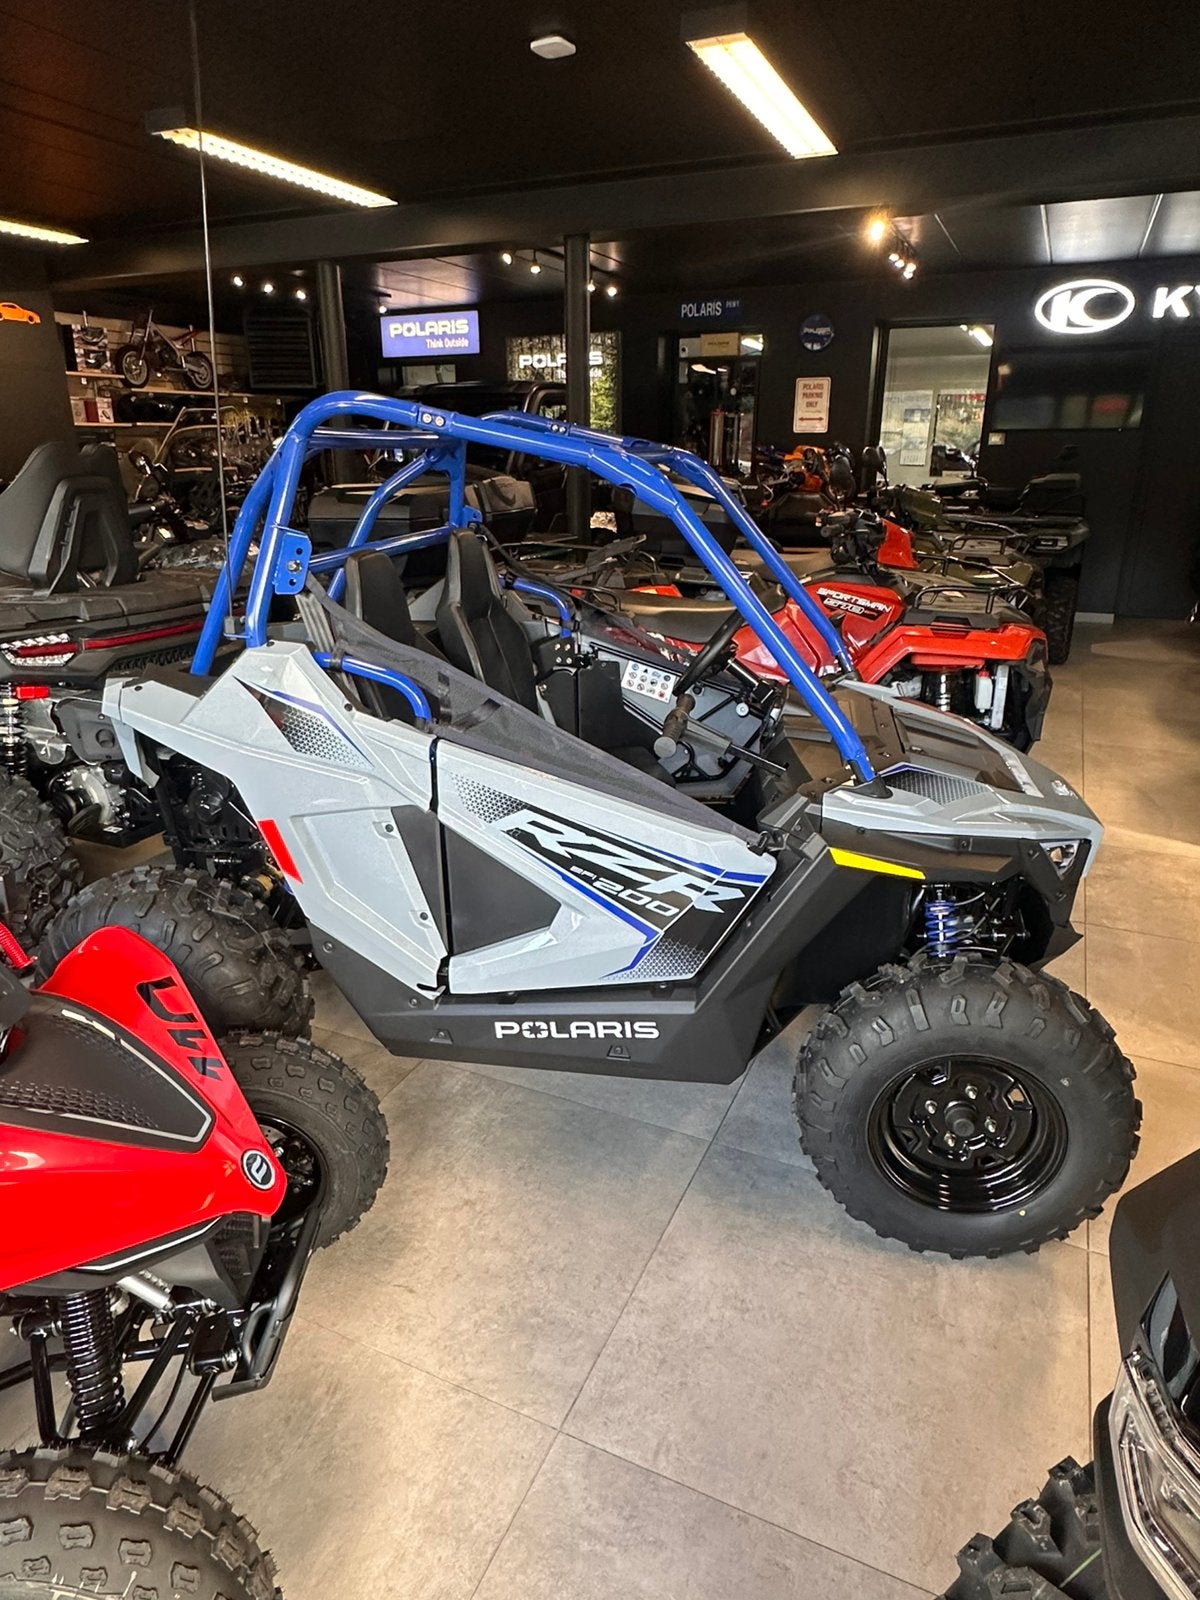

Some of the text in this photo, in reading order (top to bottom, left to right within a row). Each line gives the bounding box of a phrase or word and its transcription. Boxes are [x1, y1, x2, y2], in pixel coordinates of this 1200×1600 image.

[681, 302, 722, 318] POLARIS
[389, 319, 469, 338] POLARIS
[425, 337, 469, 349] Think Outside
[816, 587, 892, 613] SPORTSMAN
[492, 809, 746, 913] RZR
[592, 877, 680, 917] 200
[494, 1021, 660, 1039] POLARIS
